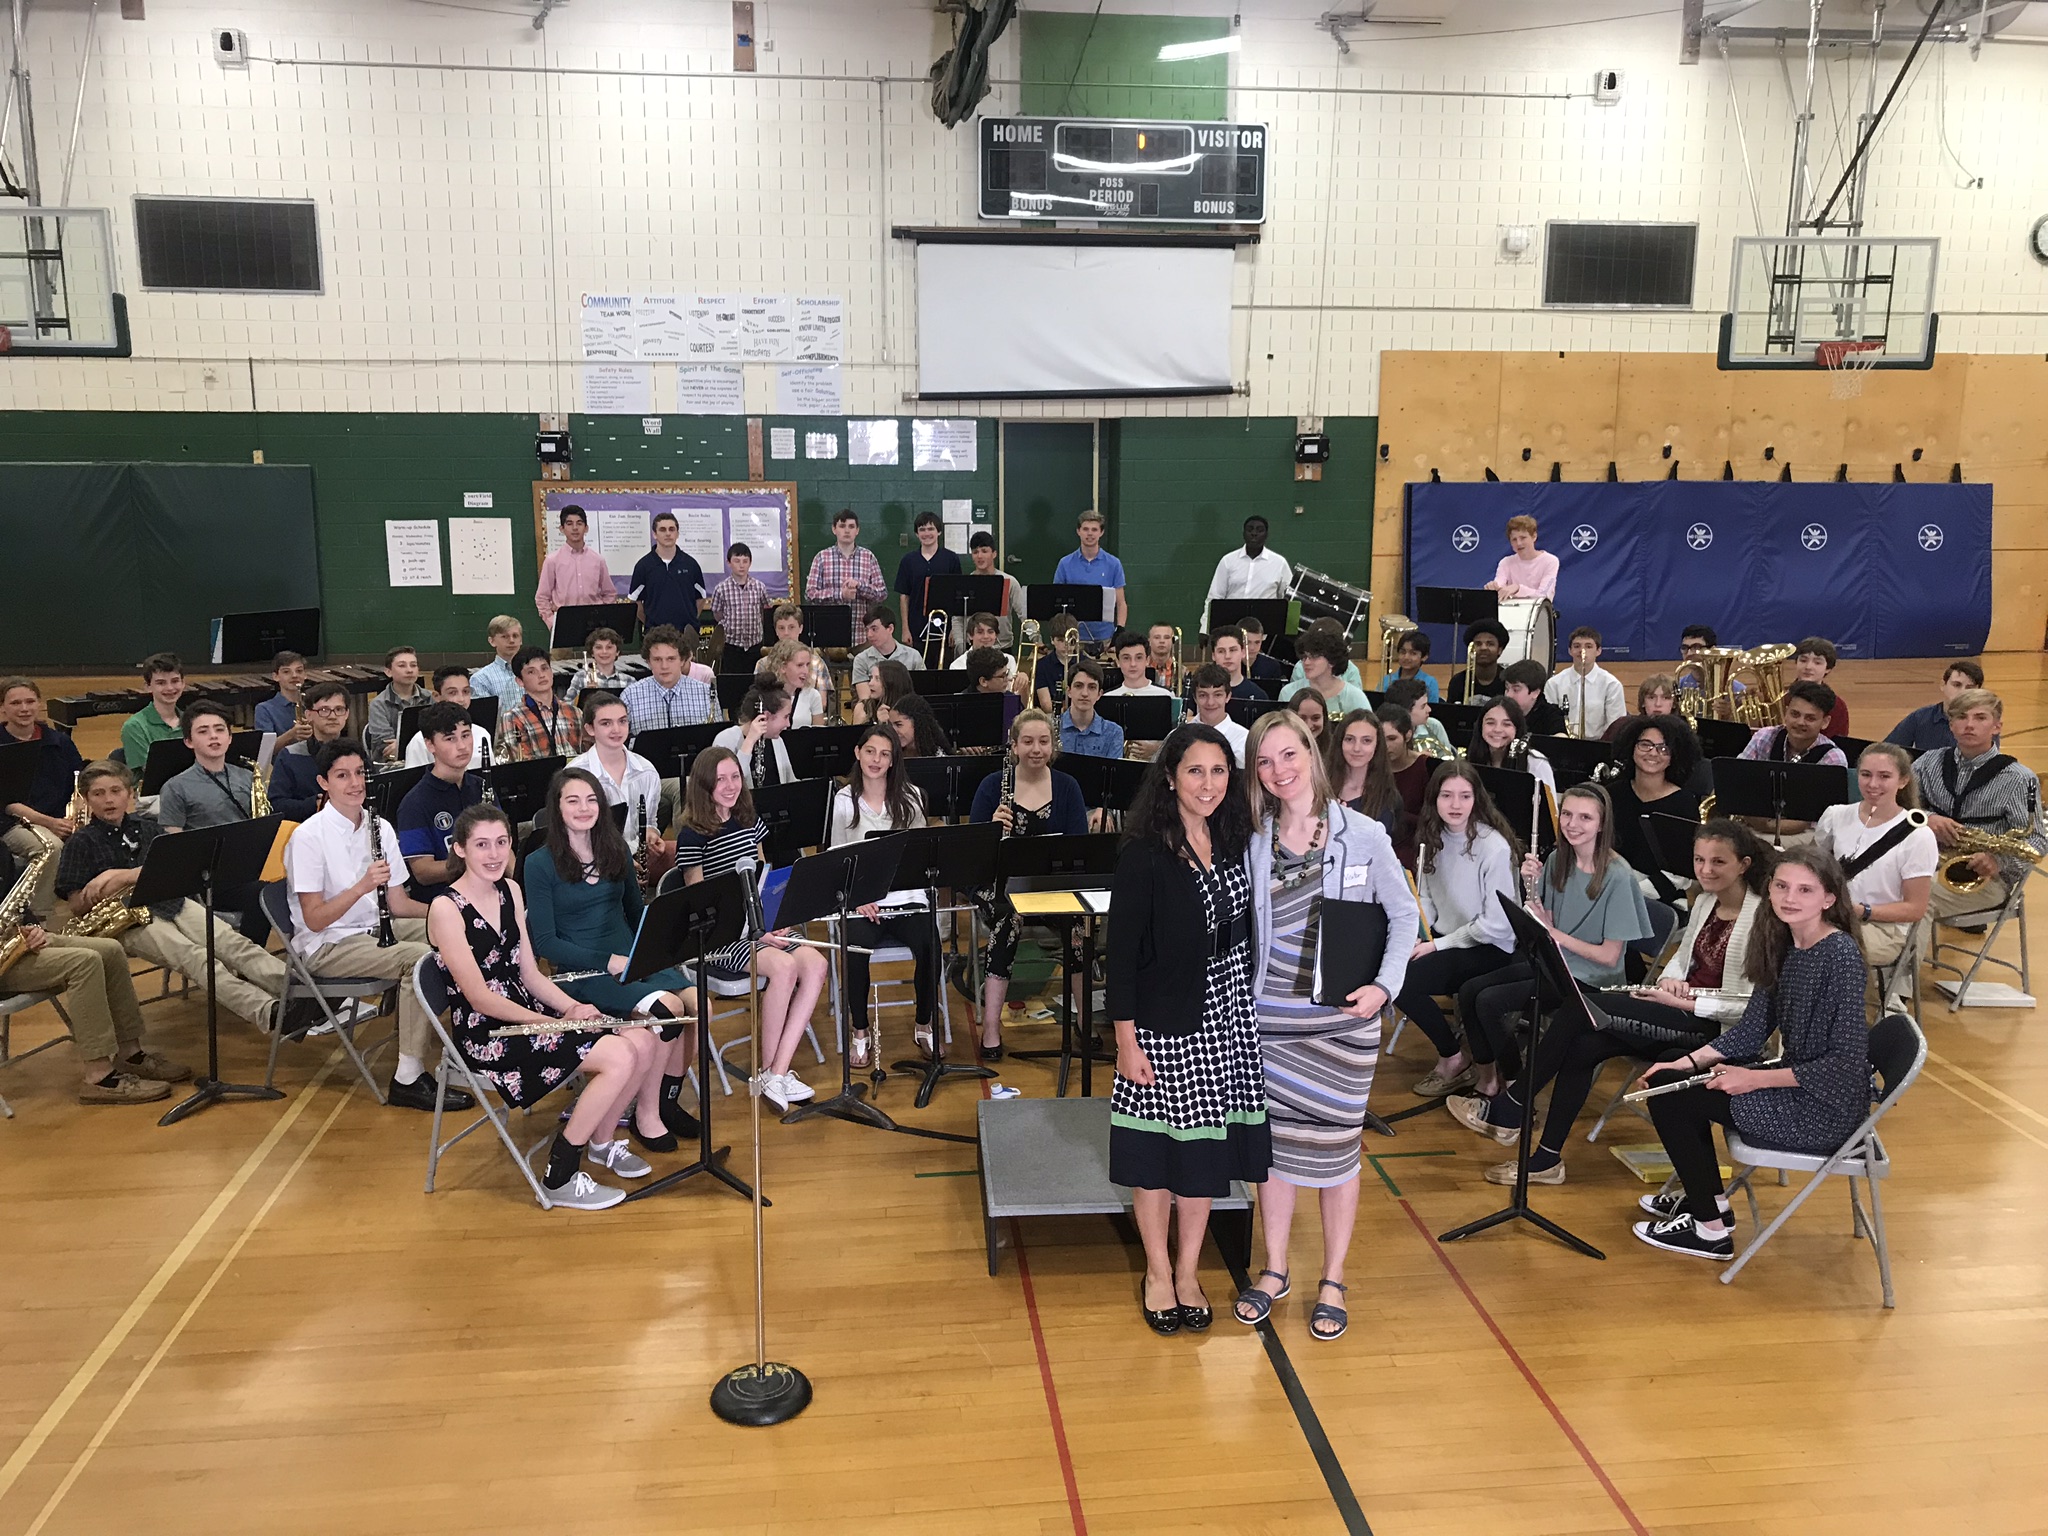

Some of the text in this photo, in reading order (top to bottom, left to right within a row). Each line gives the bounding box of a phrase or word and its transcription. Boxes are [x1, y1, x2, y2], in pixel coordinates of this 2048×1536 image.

[993, 124, 1043, 143] HOME
[1198, 130, 1263, 149] VISITOR
[1100, 177, 1124, 188] POSS
[1089, 189, 1134, 203] PERIOD
[1011, 197, 1053, 211] BONUS
[1194, 201, 1235, 214] BONUS
[600, 310, 615, 318] TEAM
[688, 310, 709, 319] LISTENING
[768, 315, 785, 324] SUCCESS
[799, 324, 812, 332] KNOW
[586, 349, 617, 357] RESPONSIBLE
[689, 342, 715, 353] COURTESY
[679, 364, 741, 375] Spirit of the Game
[1607, 1014, 1706, 1042] NIKE RUNNING
